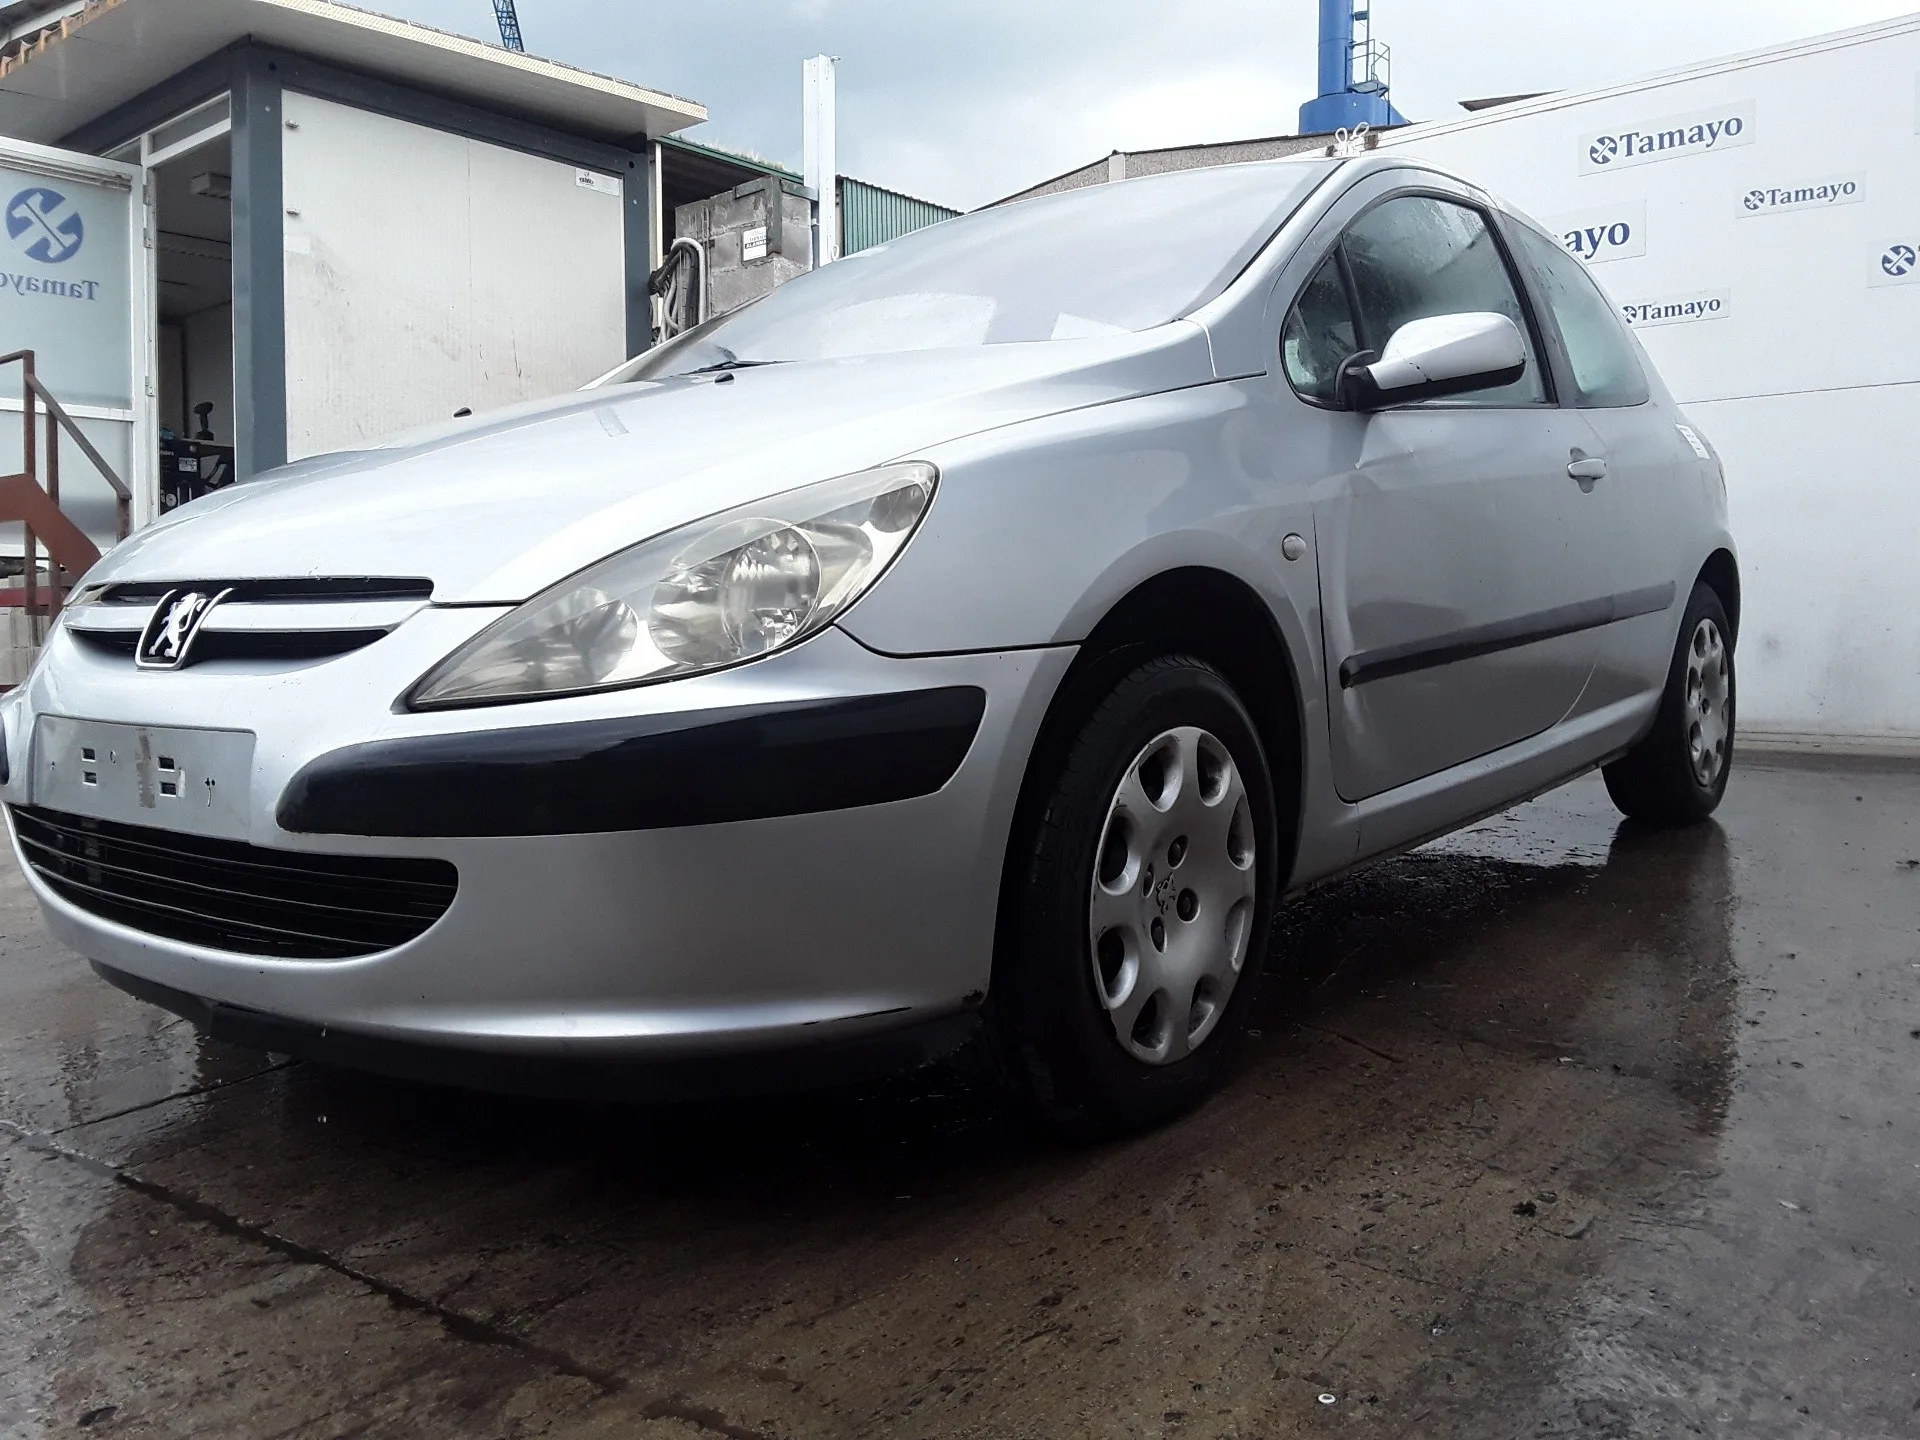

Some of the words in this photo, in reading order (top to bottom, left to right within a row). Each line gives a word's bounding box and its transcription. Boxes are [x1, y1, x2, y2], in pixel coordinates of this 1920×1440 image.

[1619, 117, 1743, 157] Tamayo
[1766, 181, 1856, 206] Tamayo
[1554, 222, 1630, 260] ayo
[1638, 298, 1721, 321] Tamayo
